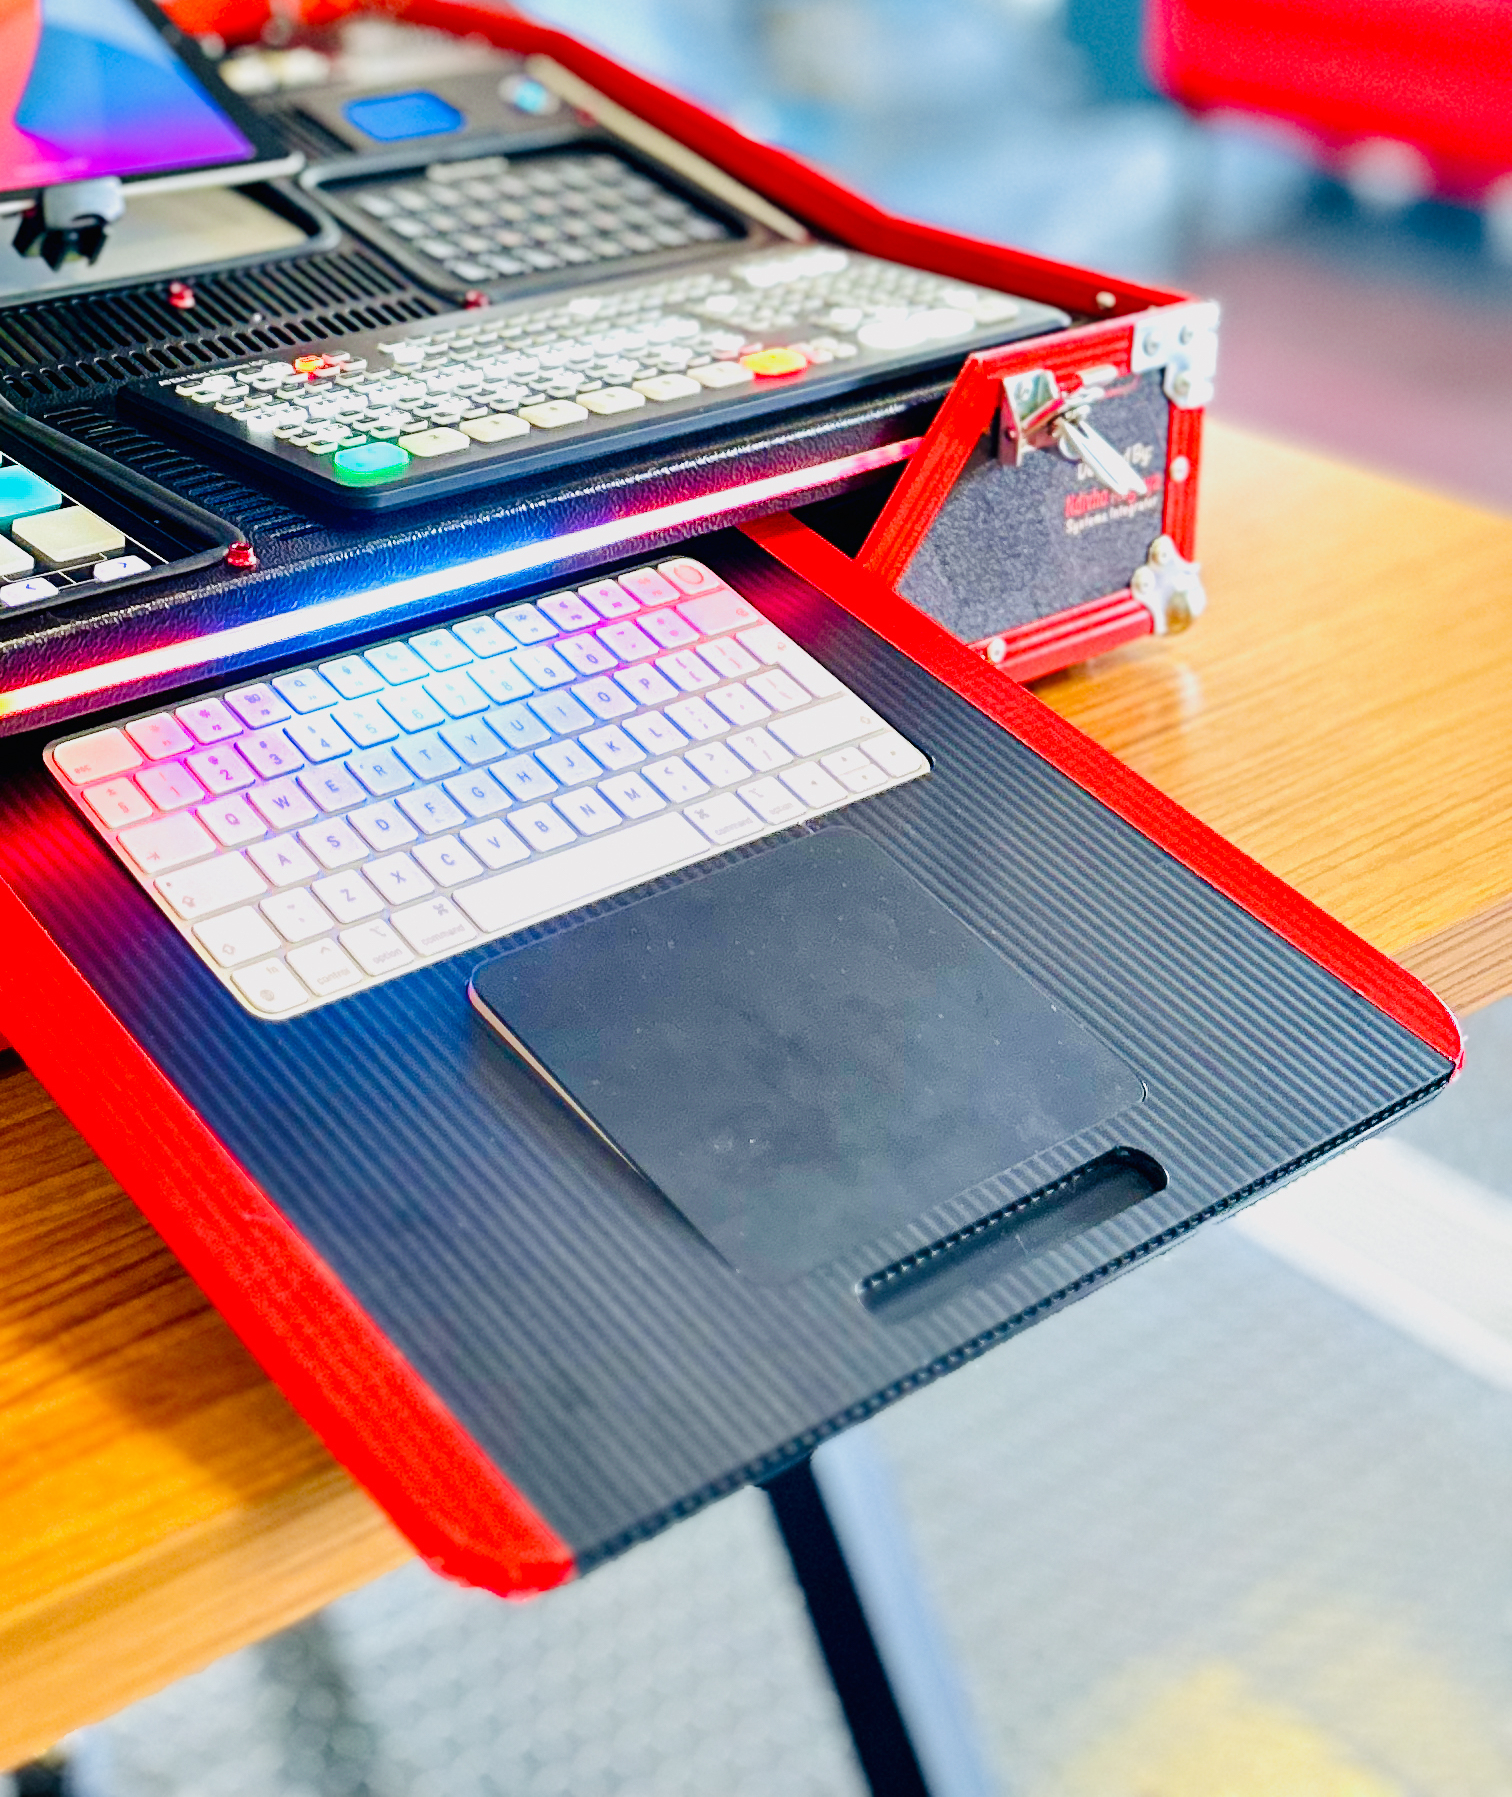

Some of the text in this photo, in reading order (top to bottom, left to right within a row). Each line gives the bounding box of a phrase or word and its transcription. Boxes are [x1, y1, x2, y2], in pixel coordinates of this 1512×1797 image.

[219, 768, 234, 781] 2
[268, 753, 283, 765] 3
[320, 737, 332, 749] 4
[365, 723, 378, 734] 5
[411, 708, 425, 721] 6
[455, 694, 467, 705] 7
[500, 680, 514, 692] 8
[543, 667, 557, 678] 9
[586, 653, 599, 664] 0
[224, 677, 651, 826] Q W E R T Y U I O P
[276, 727, 663, 867] A S D F G H J K L
[339, 787, 641, 903] Z X C V B N M
[316, 967, 351, 986] control
[372, 947, 403, 965] option
[420, 922, 467, 945] command
